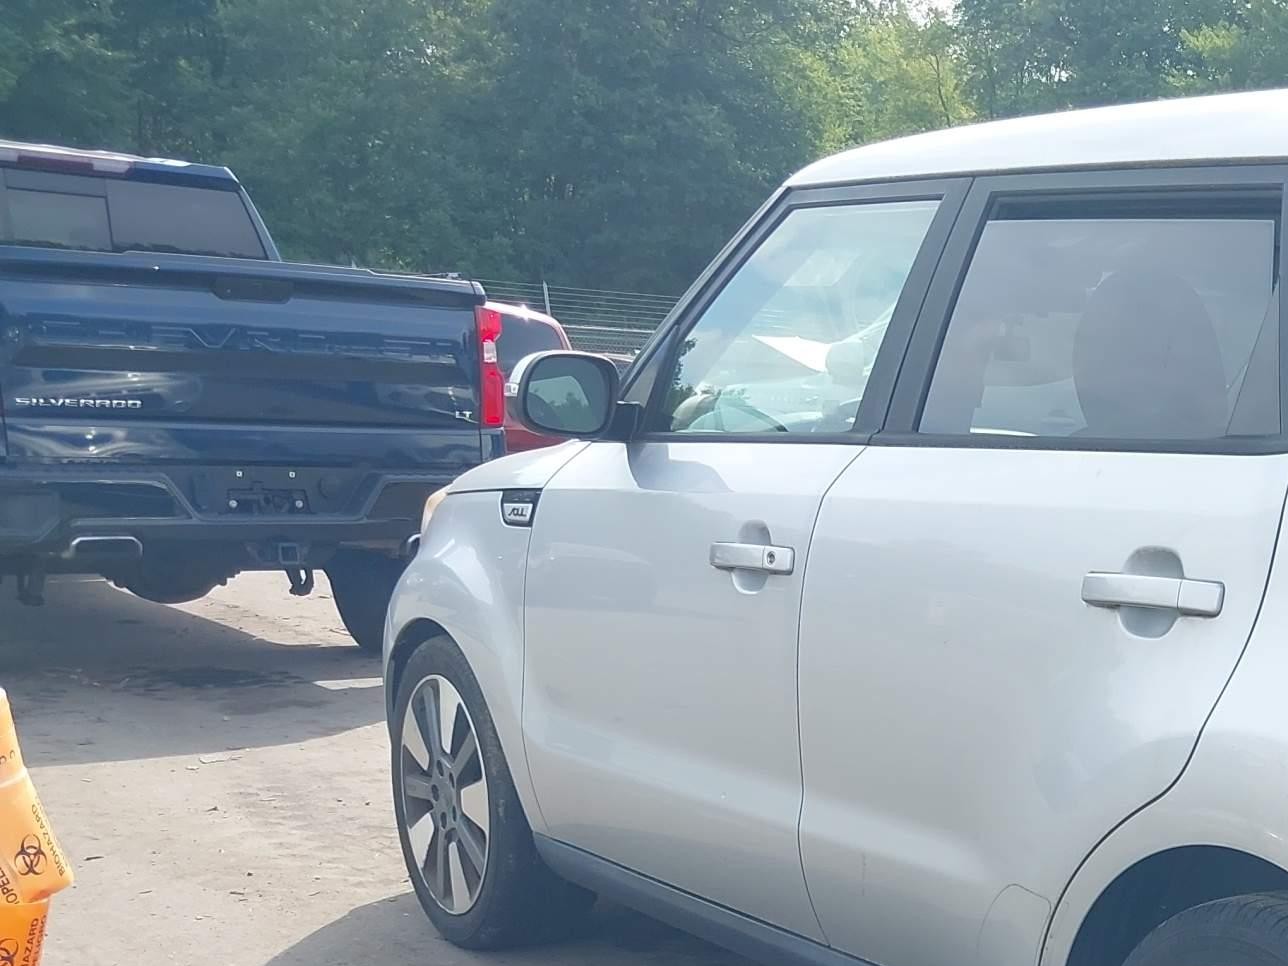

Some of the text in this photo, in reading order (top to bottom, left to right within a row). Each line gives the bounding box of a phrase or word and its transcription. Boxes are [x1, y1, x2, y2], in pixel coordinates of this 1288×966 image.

[15, 397, 142, 409] SILVERADO
[455, 411, 472, 419] LT
[31, 803, 66, 876] BIOHAZARD
